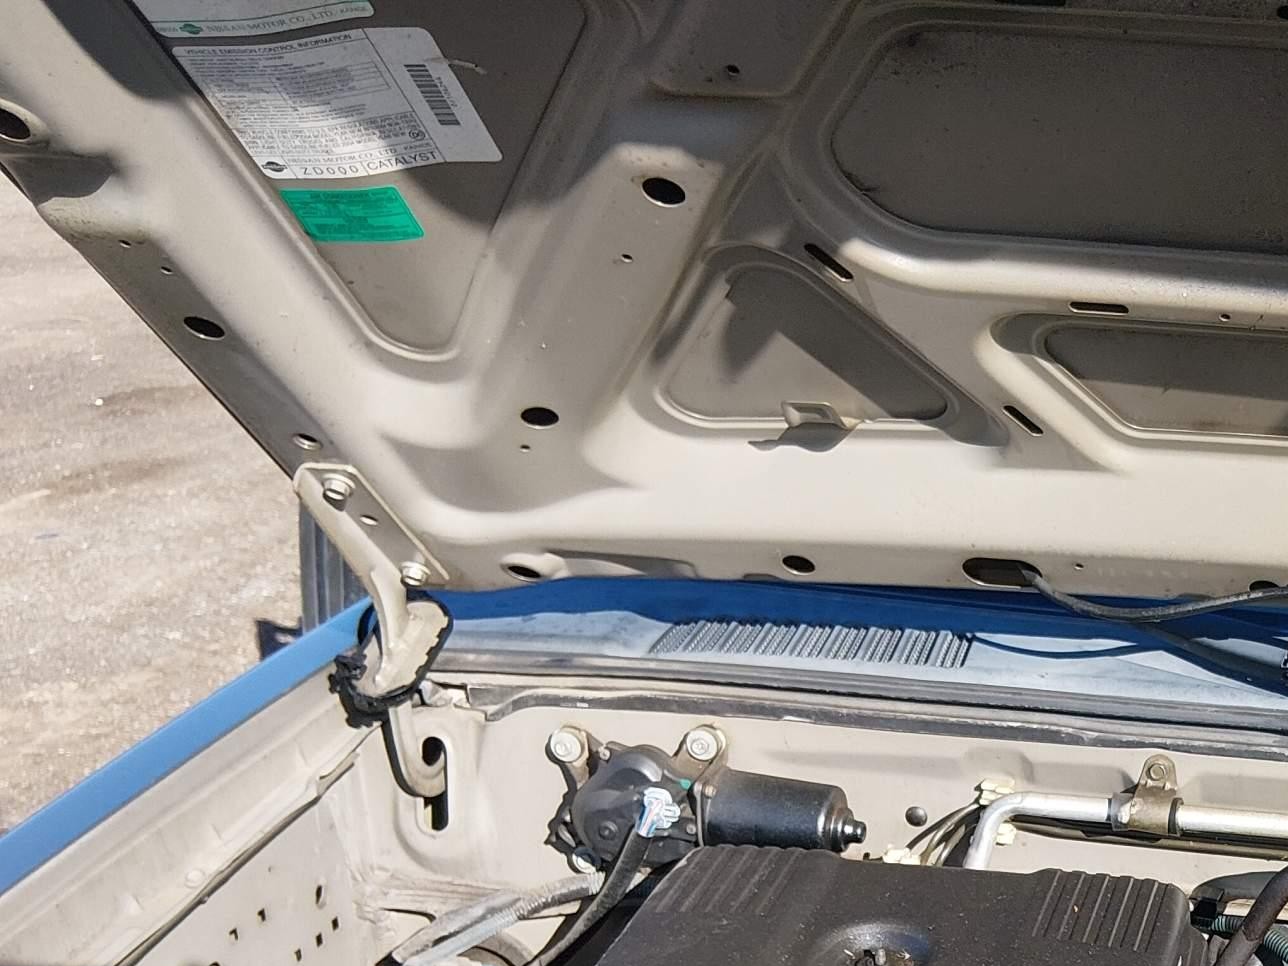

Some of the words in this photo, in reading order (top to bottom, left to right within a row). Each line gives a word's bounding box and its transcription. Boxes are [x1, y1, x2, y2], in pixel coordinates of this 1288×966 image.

[208, 24, 246, 33] NISSAN
[248, 19, 286, 31] MOTOR
[257, 45, 295, 54] CONTROL
[297, 33, 353, 47] INFORMATION
[323, 154, 356, 163] MOTOR
[366, 151, 437, 171] CATALYST
